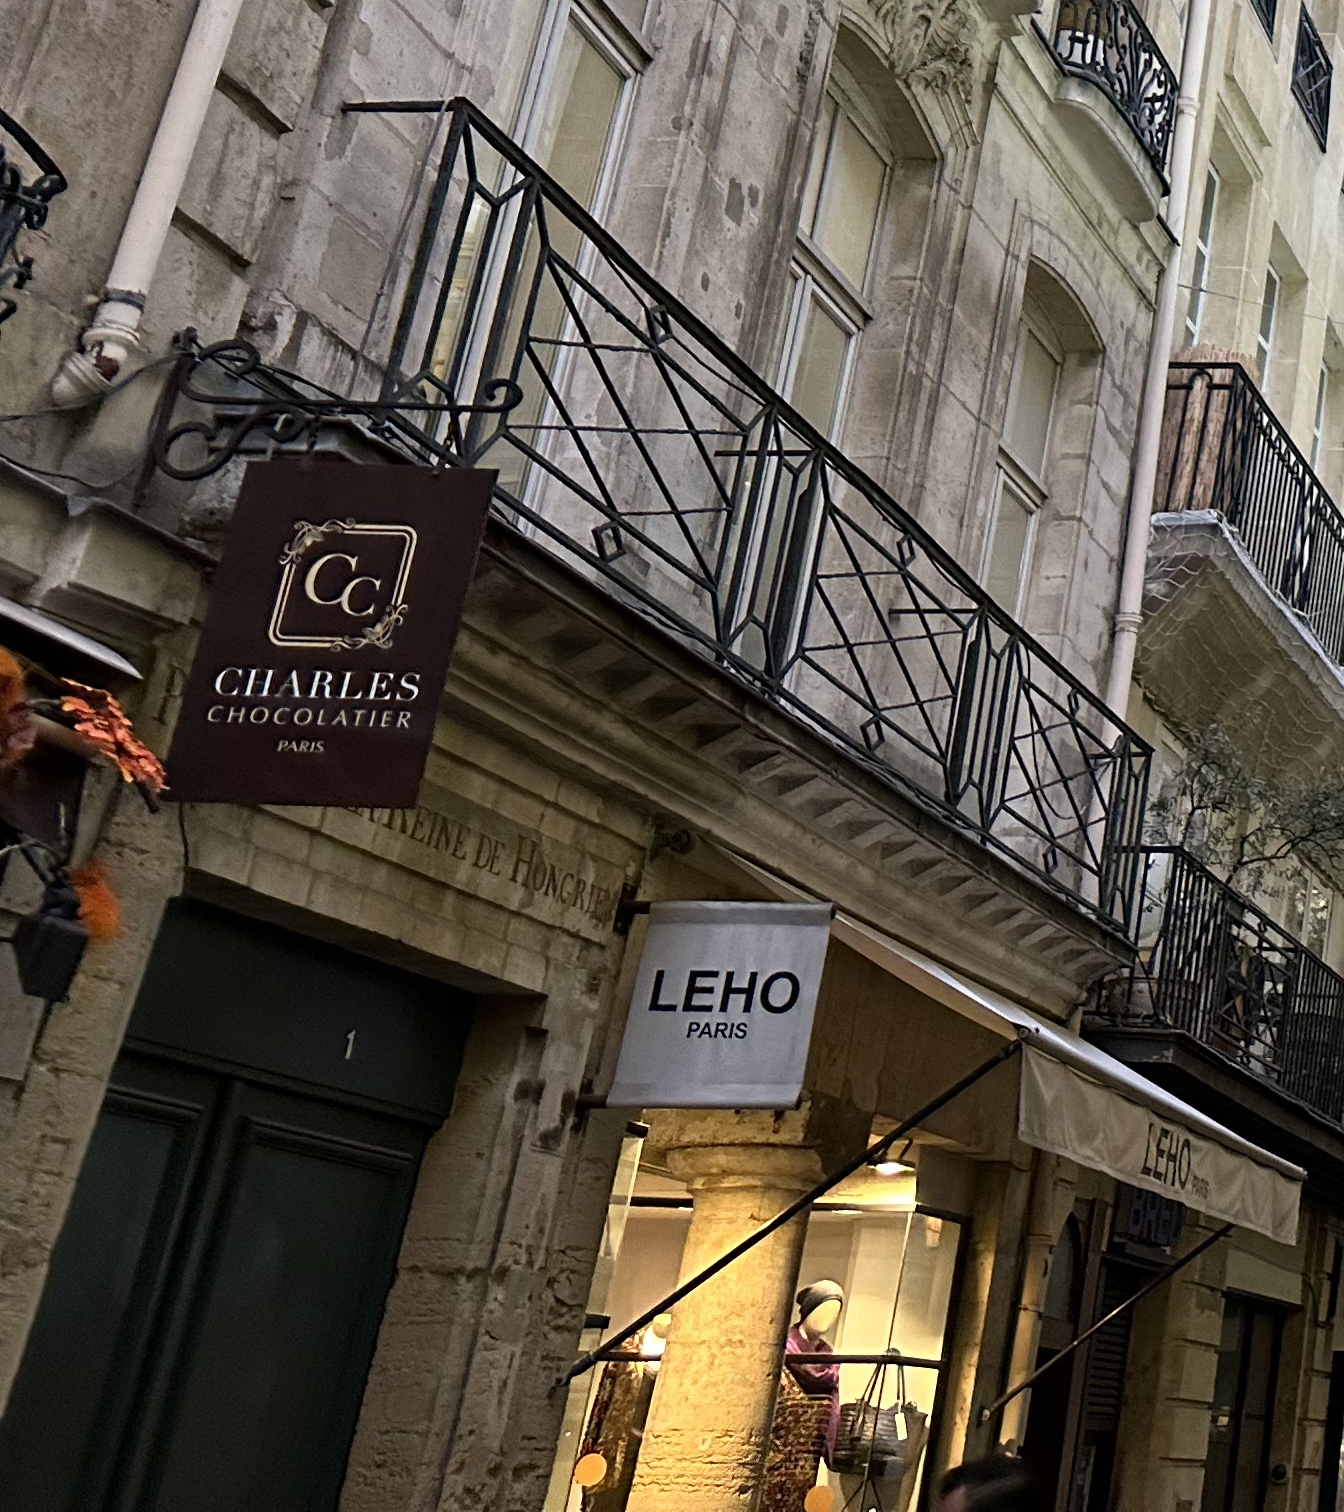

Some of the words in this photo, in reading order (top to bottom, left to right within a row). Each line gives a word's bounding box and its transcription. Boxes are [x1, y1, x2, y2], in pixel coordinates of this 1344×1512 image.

[213, 666, 422, 702] CHARLES
[206, 704, 412, 729] CHOCOLATIER
[277, 739, 326, 754] PARIS
[472, 832, 507, 876] DE
[648, 969, 801, 1015] LEHO
[344, 1030, 357, 1060] 1
[686, 1021, 748, 1040] PARIS
[1140, 1122, 1192, 1191] LEHO
